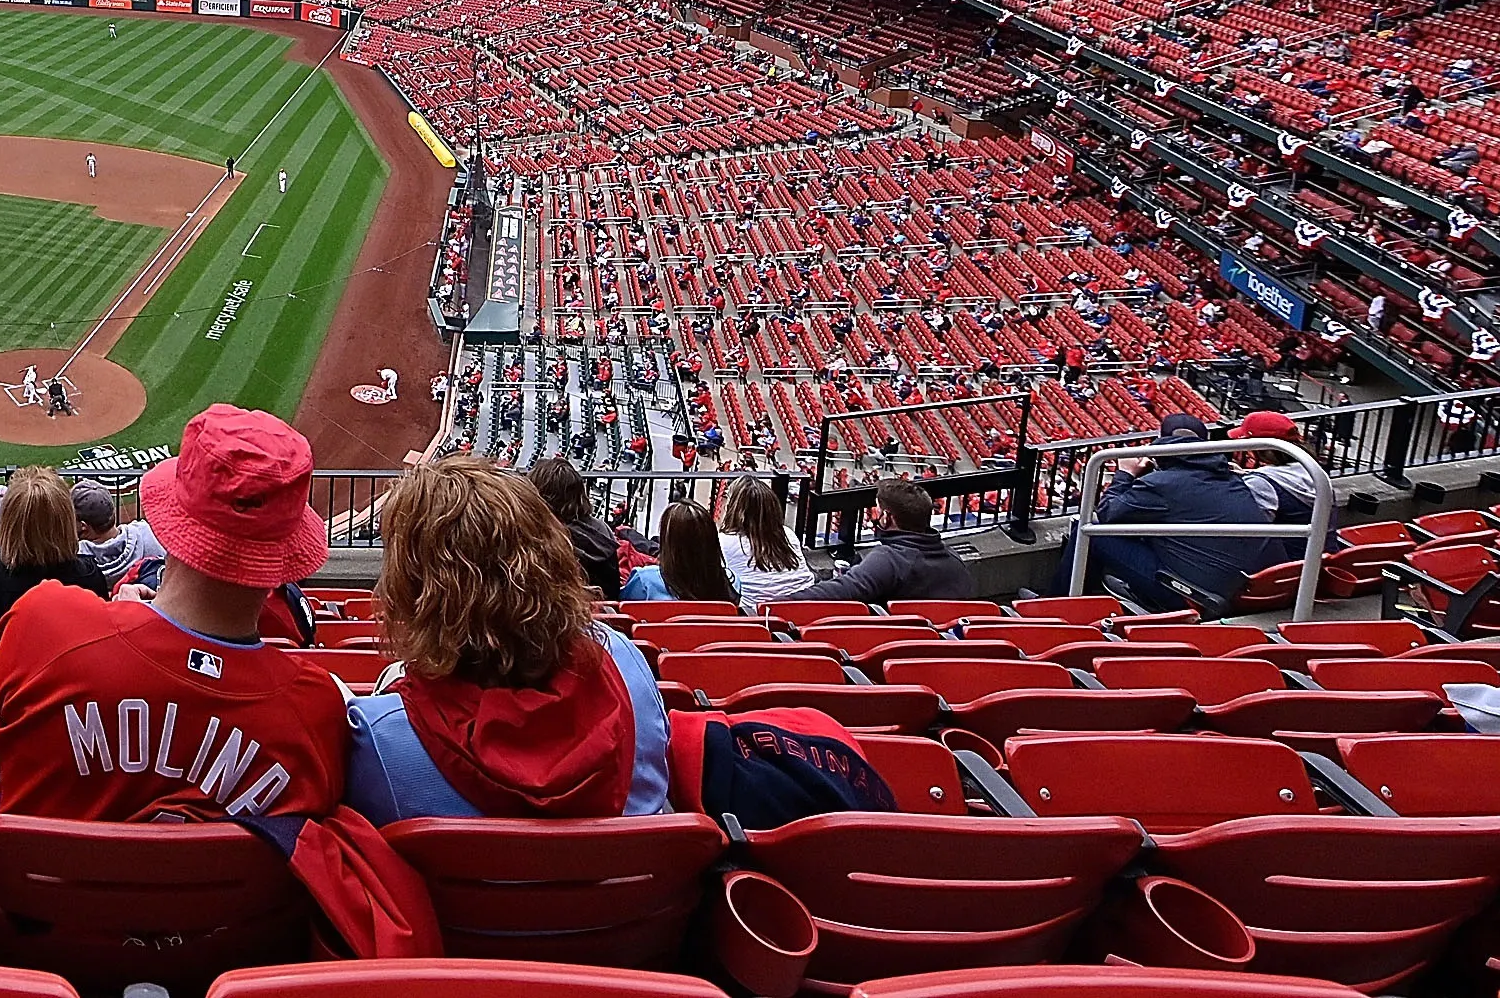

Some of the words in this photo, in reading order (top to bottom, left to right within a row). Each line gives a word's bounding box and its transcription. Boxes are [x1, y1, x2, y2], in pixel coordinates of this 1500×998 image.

[200, 0, 238, 11] PERFICIENT
[253, 4, 292, 14] EQUIFAX
[1247, 269, 1294, 315] Together
[205, 278, 253, 341] mercy.net/safe
[132, 445, 172, 464] DAY
[63, 698, 291, 817] MOLINA
